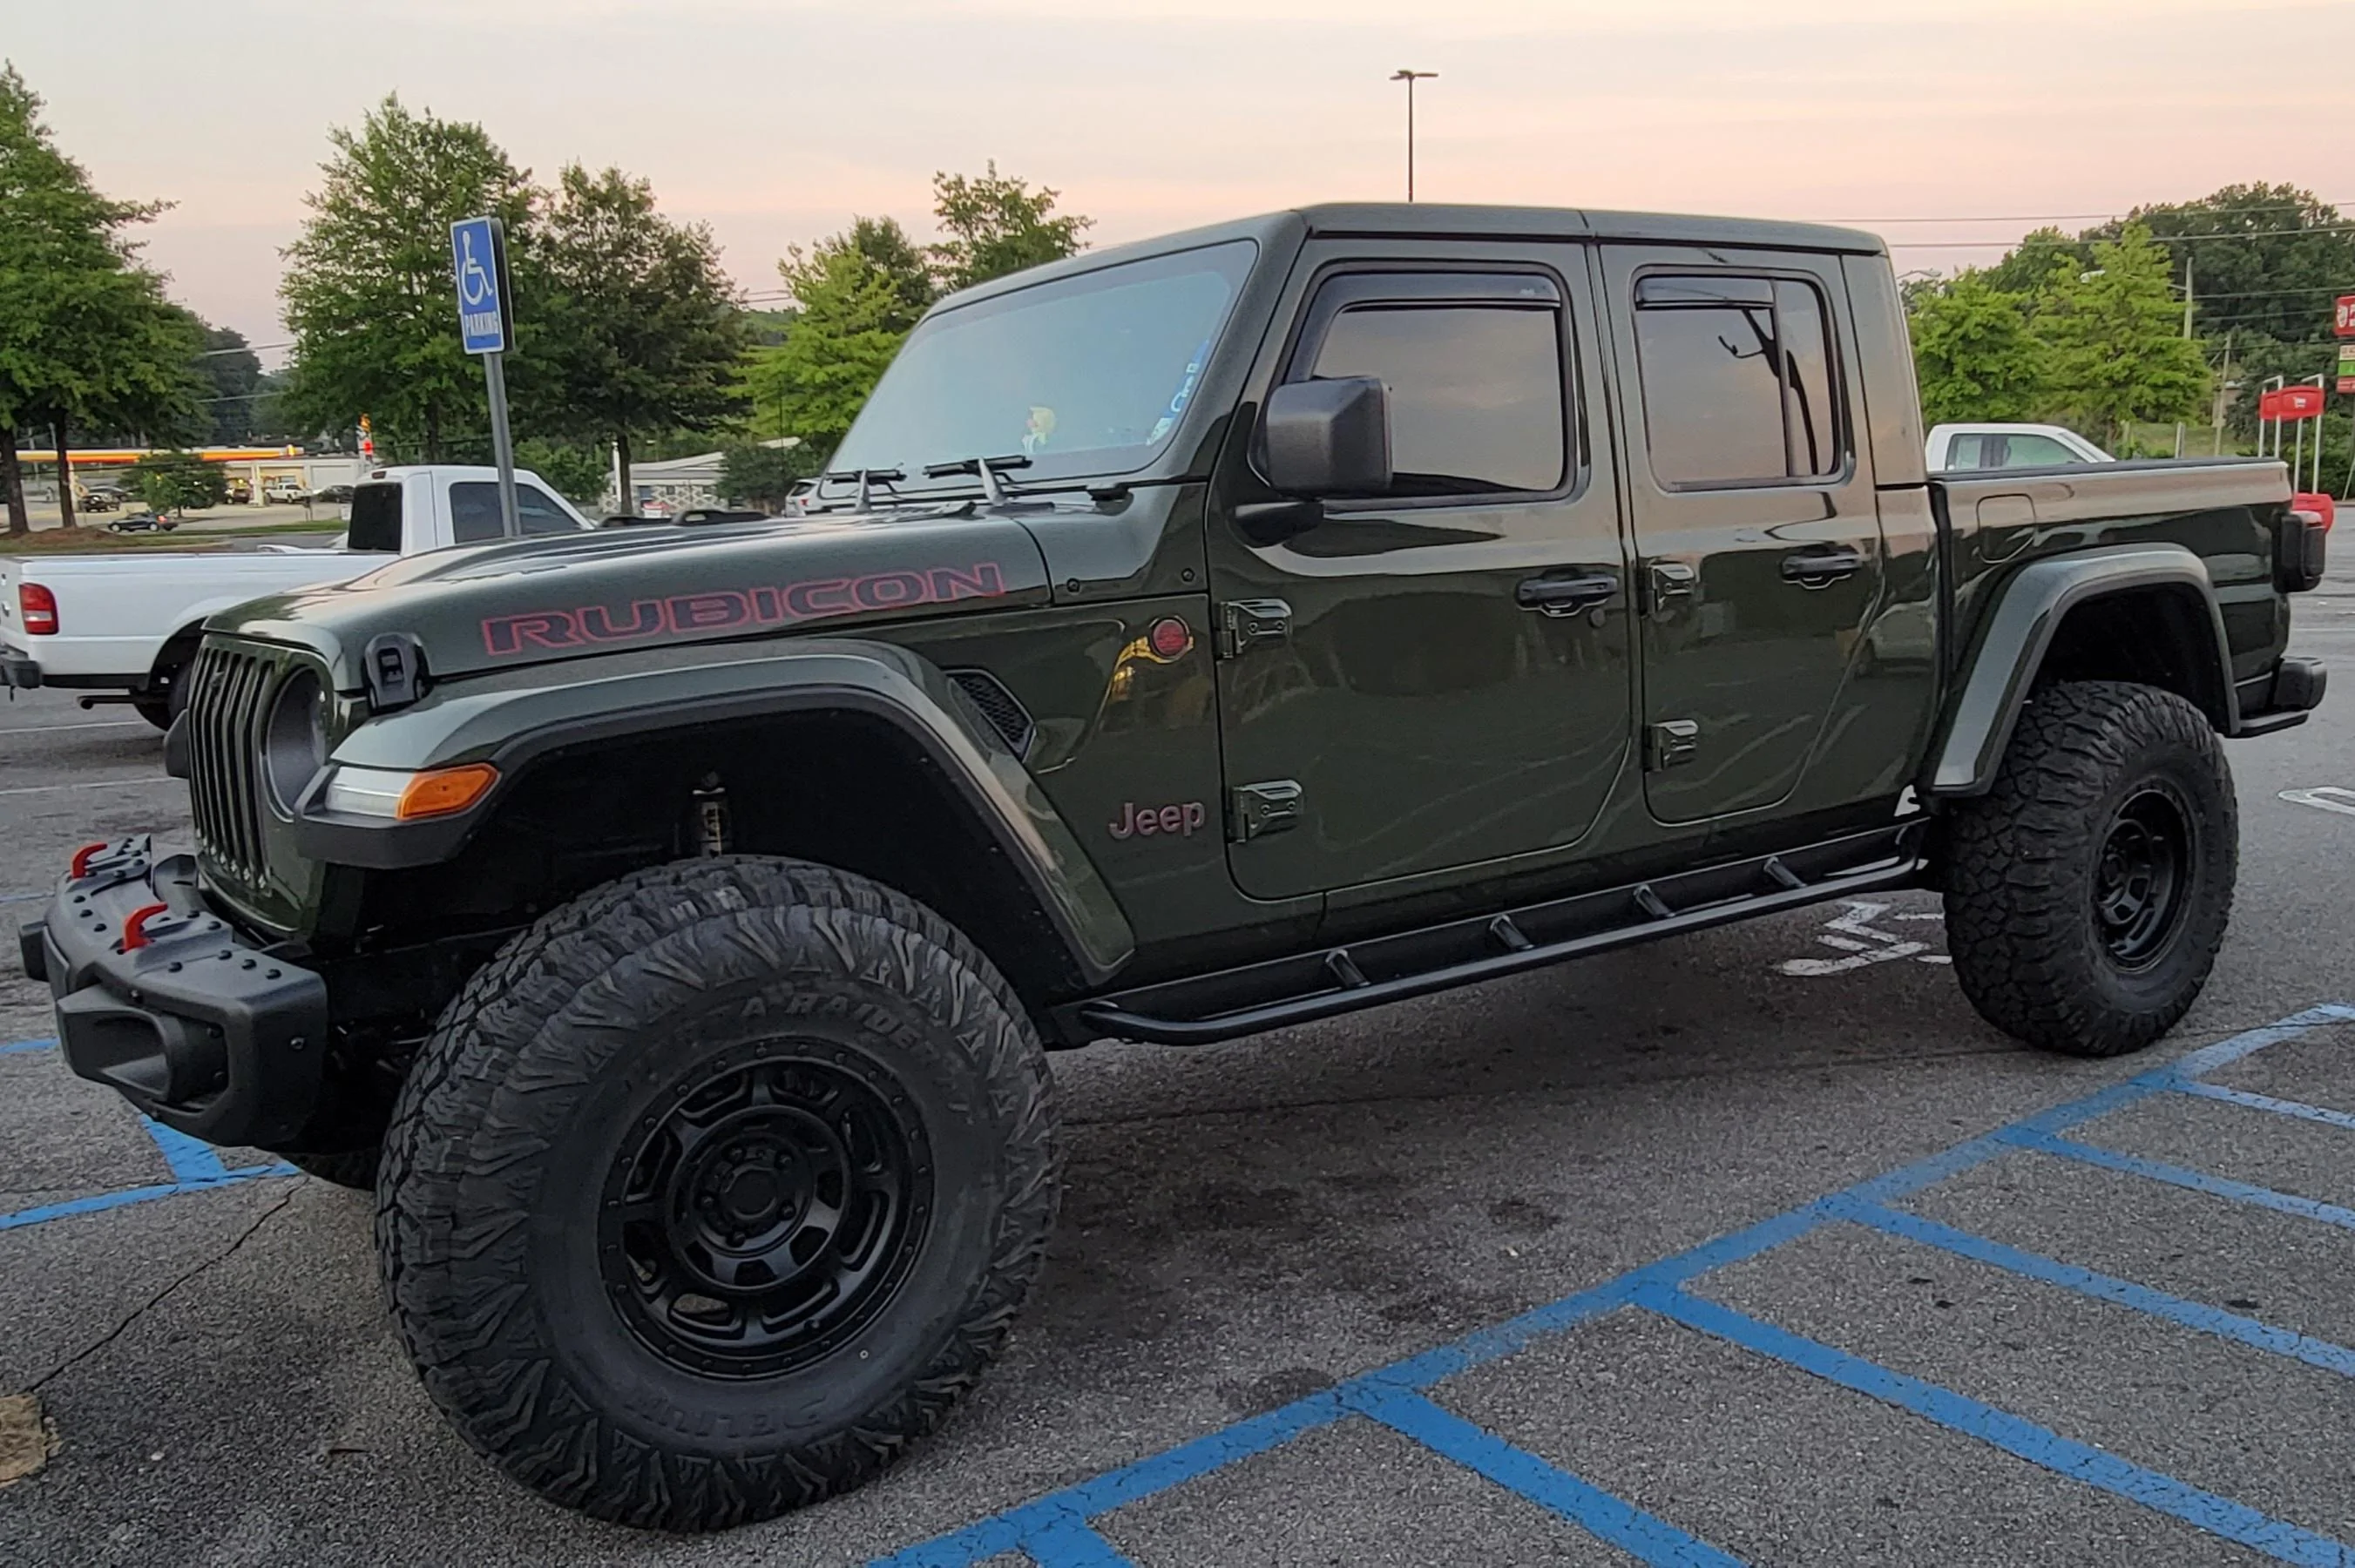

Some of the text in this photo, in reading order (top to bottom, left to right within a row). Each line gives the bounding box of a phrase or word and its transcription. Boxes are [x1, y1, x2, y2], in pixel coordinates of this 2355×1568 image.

[464, 311, 499, 337] PARKING
[482, 562, 1006, 655] RUBICON
[1108, 801, 1206, 840] Jeep
